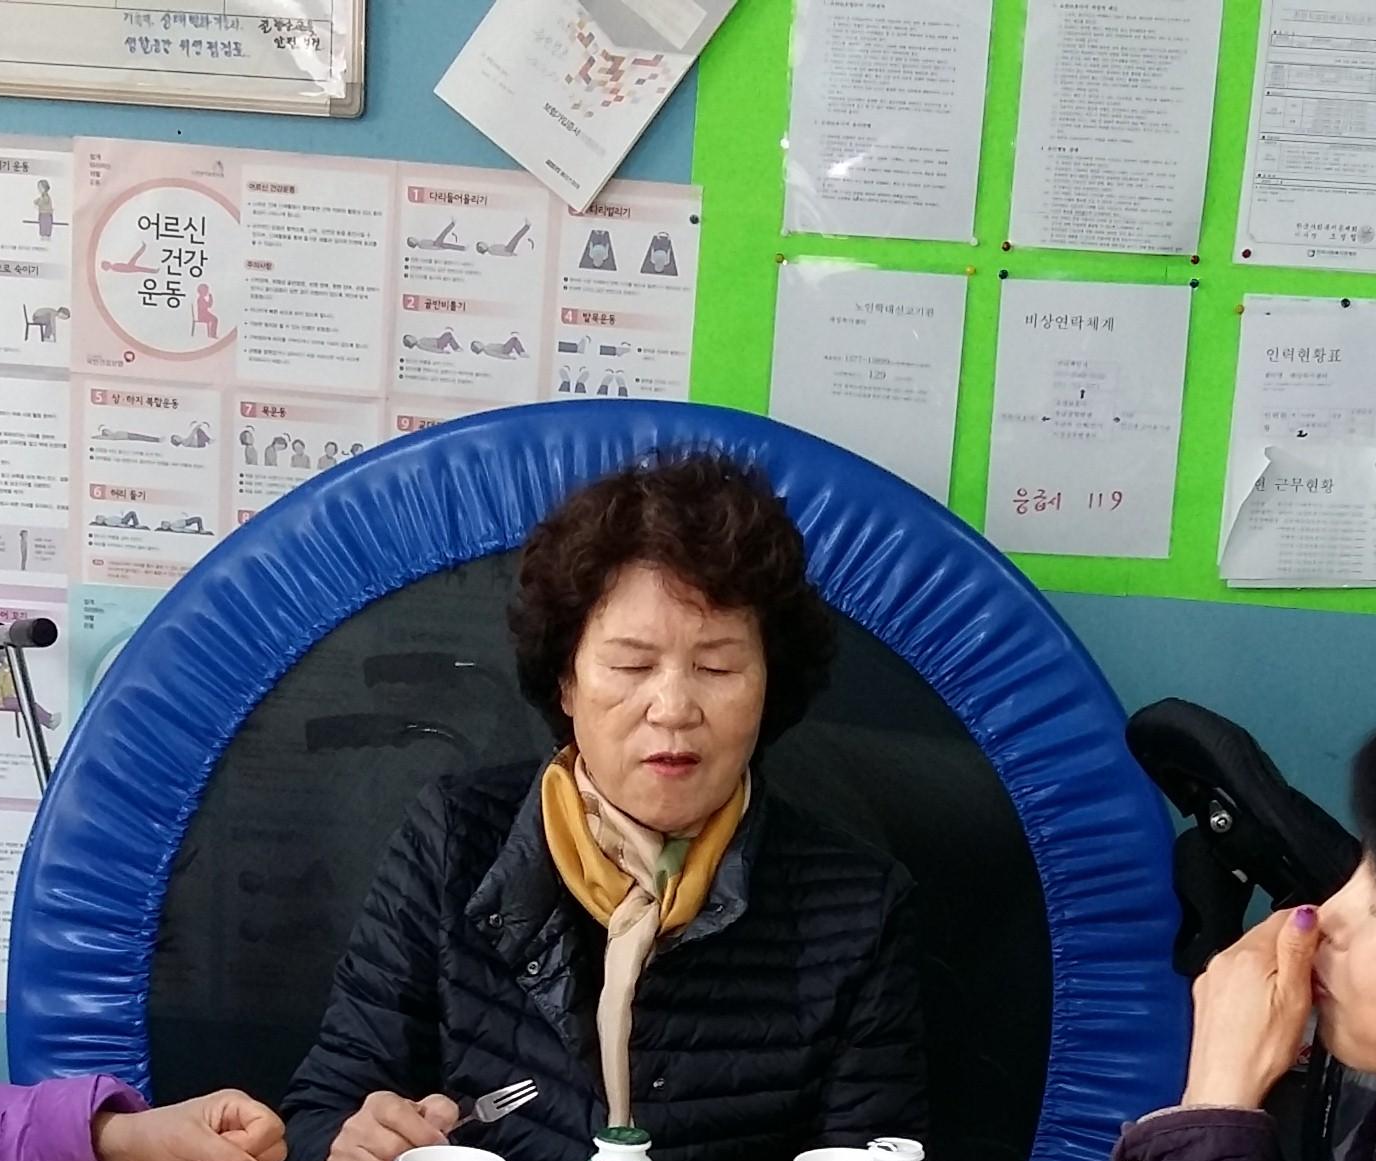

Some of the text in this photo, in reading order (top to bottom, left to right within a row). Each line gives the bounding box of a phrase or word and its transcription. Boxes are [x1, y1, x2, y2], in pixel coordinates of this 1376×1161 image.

[411, 189, 488, 206] 1 다리들어올리기
[138, 213, 206, 245] 어르신
[161, 248, 208, 278] 건강
[138, 278, 186, 309] 운동
[406, 296, 466, 312] 2 골반비틀기
[564, 310, 616, 326] 4 발목운동
[1025, 313, 1115, 333] 비상연락체계
[1266, 346, 1342, 363] 인력현황표
[95, 391, 103, 402] 5
[147, 397, 178, 410] 복합운동
[245, 404, 286, 418] 7 목운동
[93, 487, 102, 498] 6
[1012, 488, 1124, 514] 응급시 119
